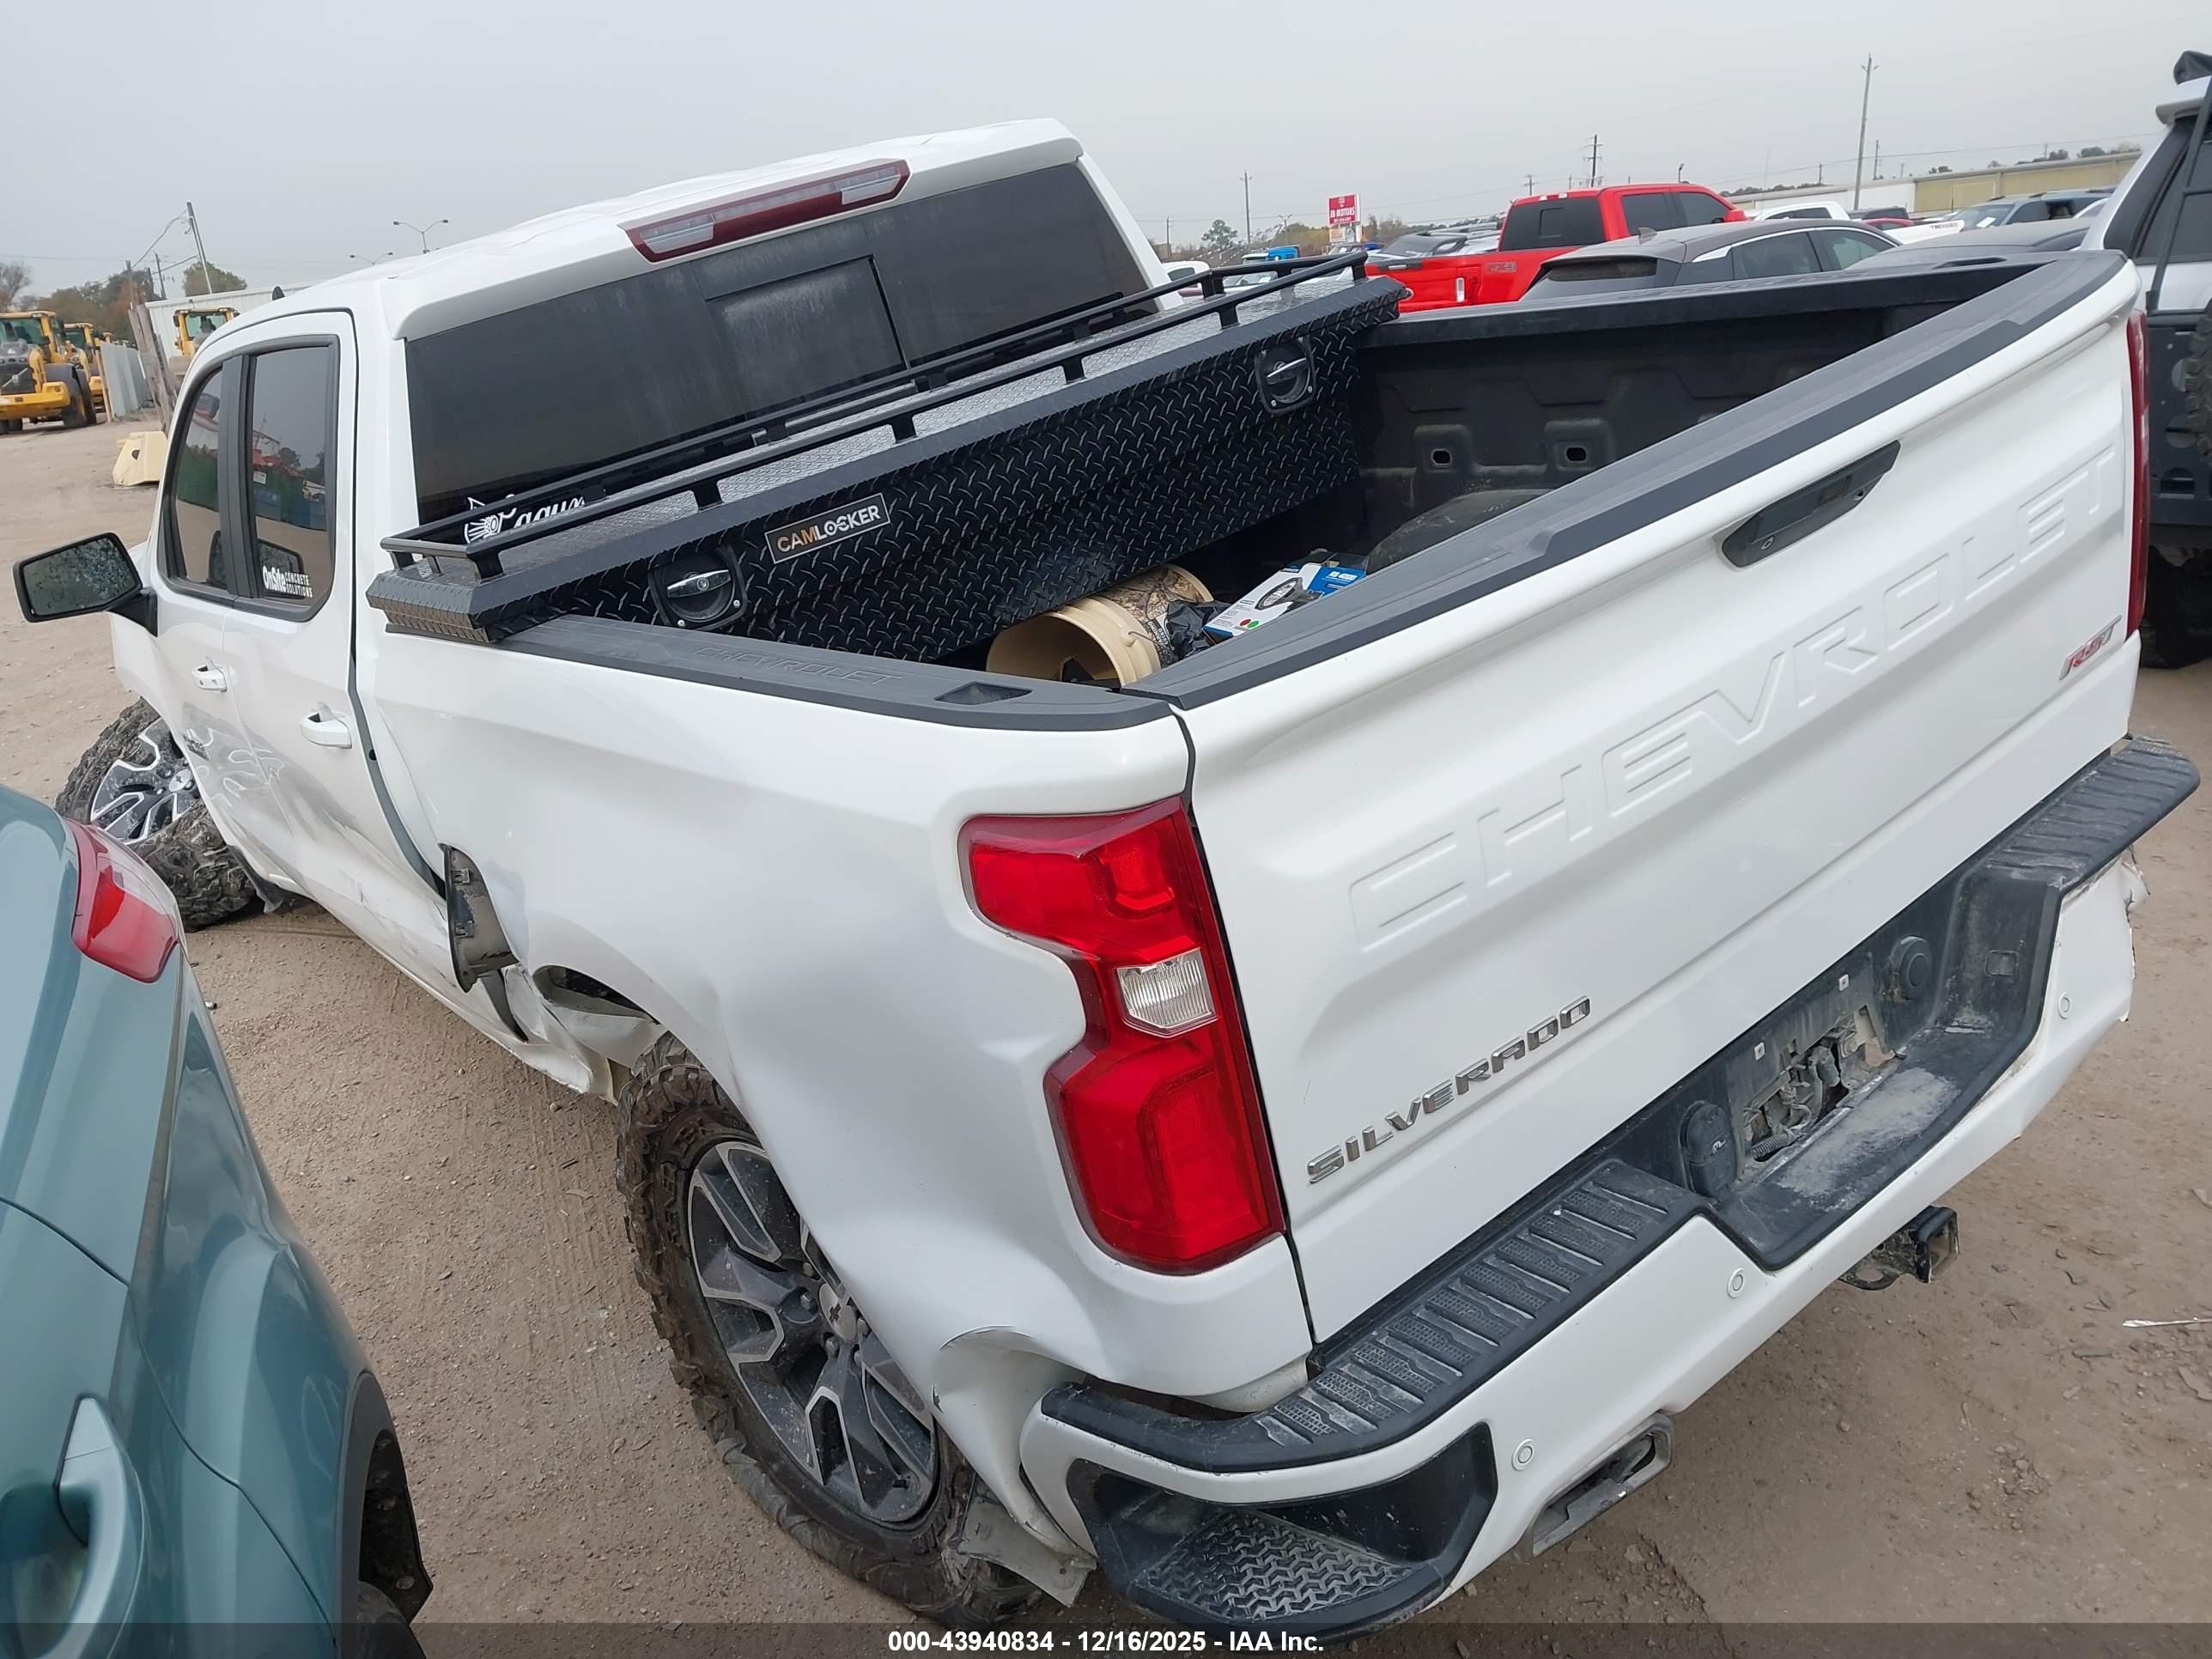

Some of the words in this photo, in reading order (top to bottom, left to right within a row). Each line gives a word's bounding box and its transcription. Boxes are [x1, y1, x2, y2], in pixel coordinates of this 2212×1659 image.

[777, 505, 882, 552] CAMLOCKER
[263, 565, 287, 593] OnSite
[286, 572, 310, 586] CONCRETE
[286, 584, 313, 599] SOLUTIONS
[693, 647, 903, 685] CHEVROLET
[2059, 613, 2123, 681] RST
[1350, 444, 2116, 955] CHEVROLET
[1307, 994, 1591, 1186] SILVERADO
